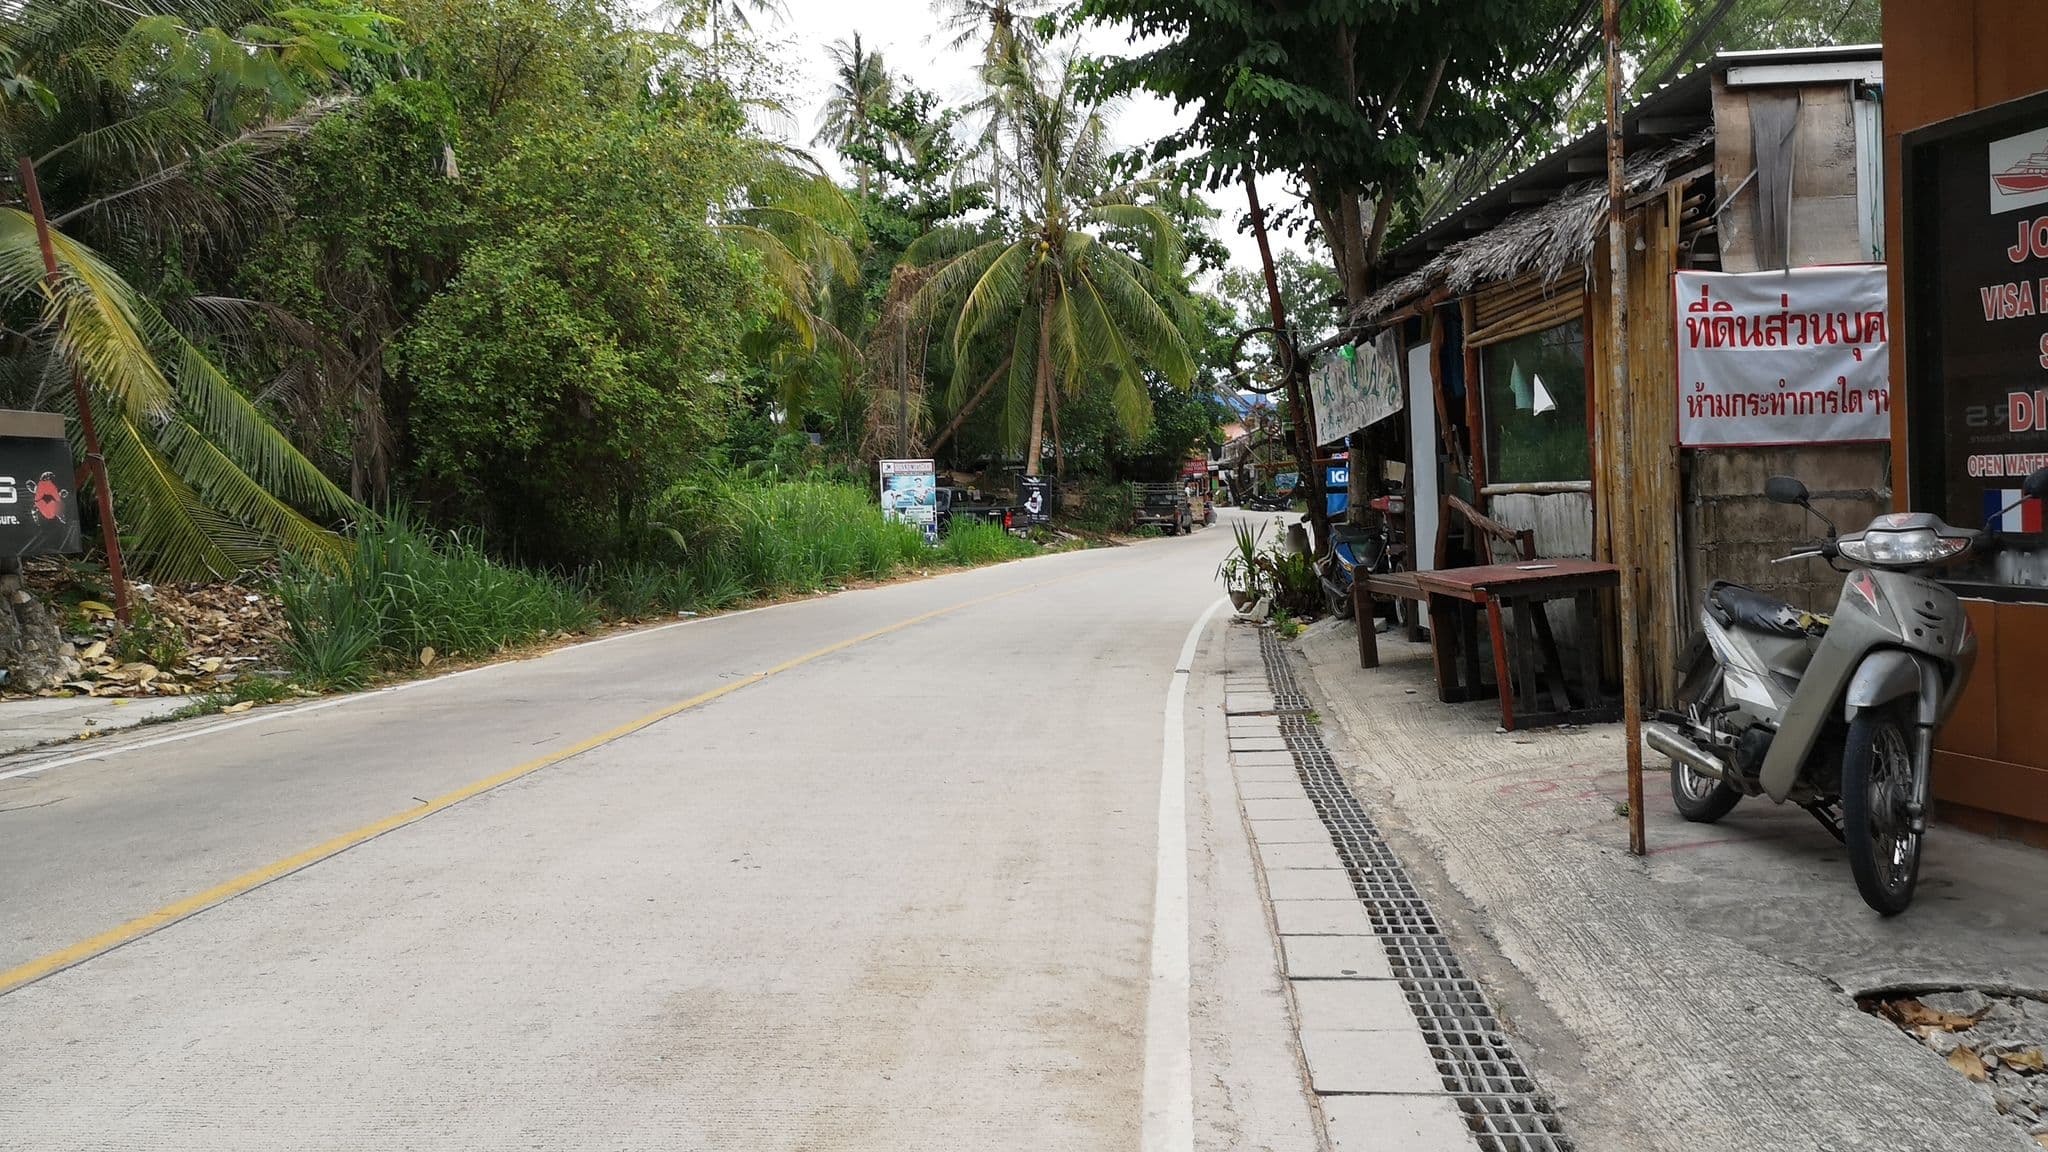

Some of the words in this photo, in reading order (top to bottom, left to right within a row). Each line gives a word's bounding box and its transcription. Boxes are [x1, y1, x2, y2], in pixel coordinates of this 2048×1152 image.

[2007, 216, 2048, 263] JO
[1980, 280, 2036, 321] VISA
[1967, 454, 2004, 478] OPEN
